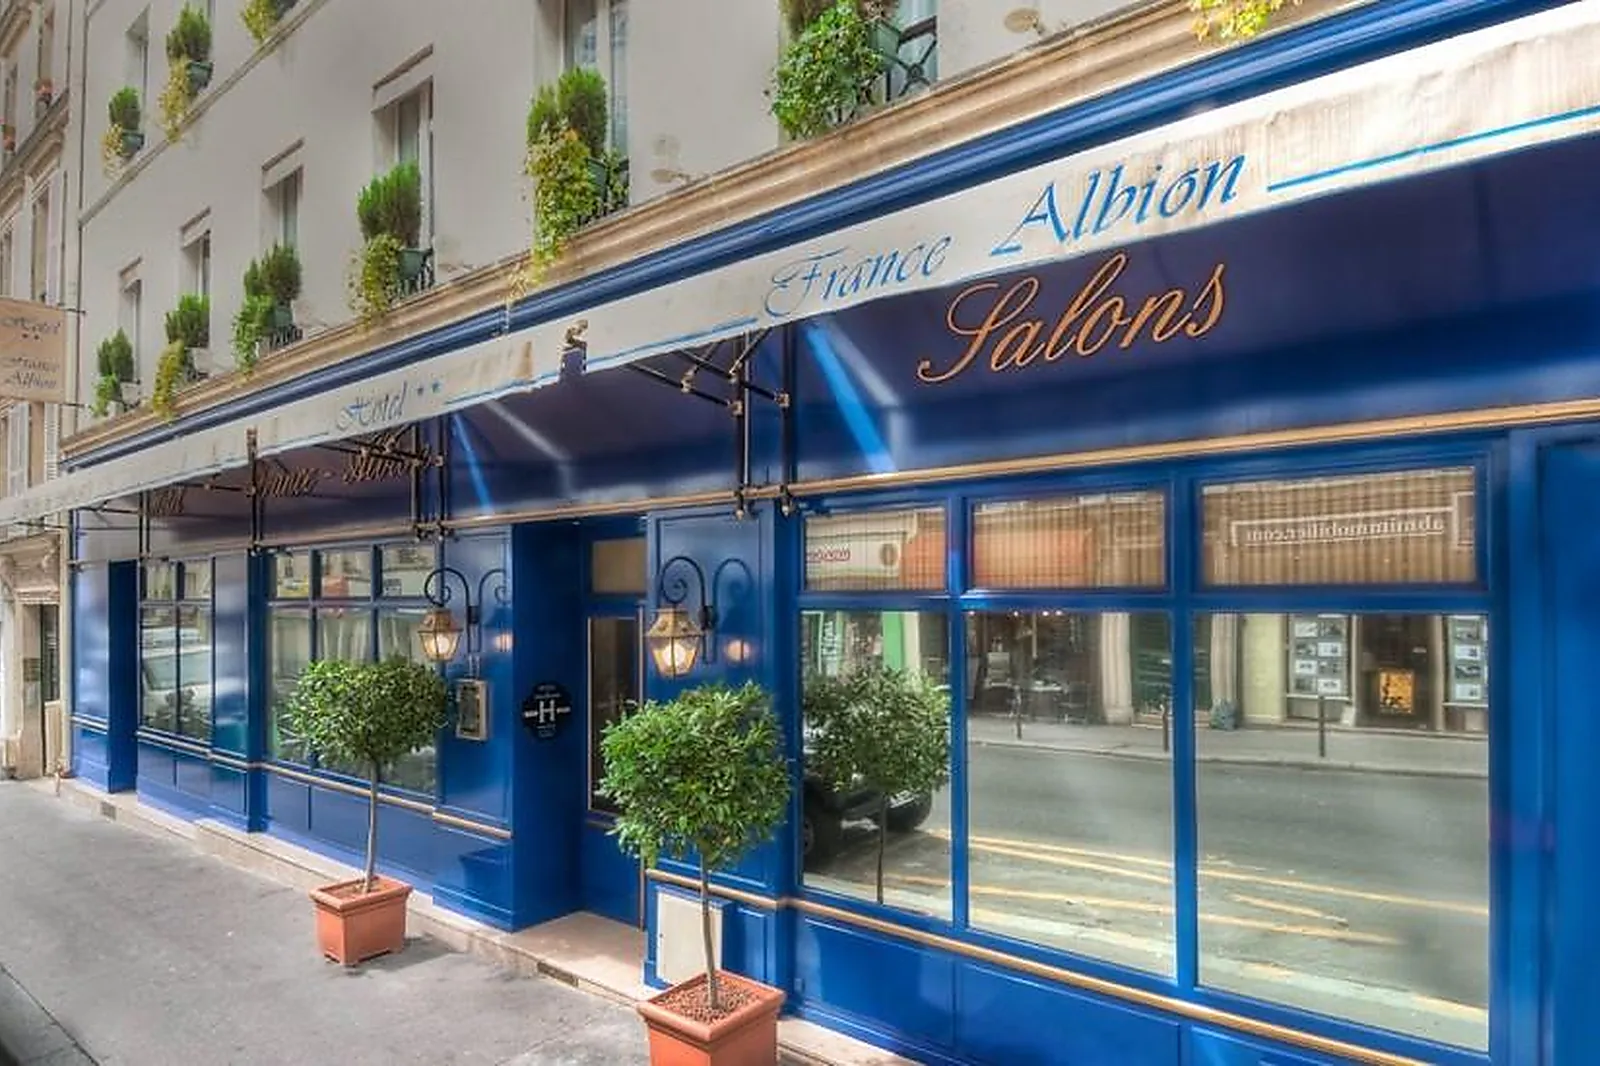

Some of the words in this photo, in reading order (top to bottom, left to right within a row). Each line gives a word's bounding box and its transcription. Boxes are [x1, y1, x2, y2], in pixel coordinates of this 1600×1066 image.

[764, 236, 951, 317] France
[991, 154, 1246, 255] Albion
[916, 251, 1226, 383] Salons
[539, 699, 556, 723] H
